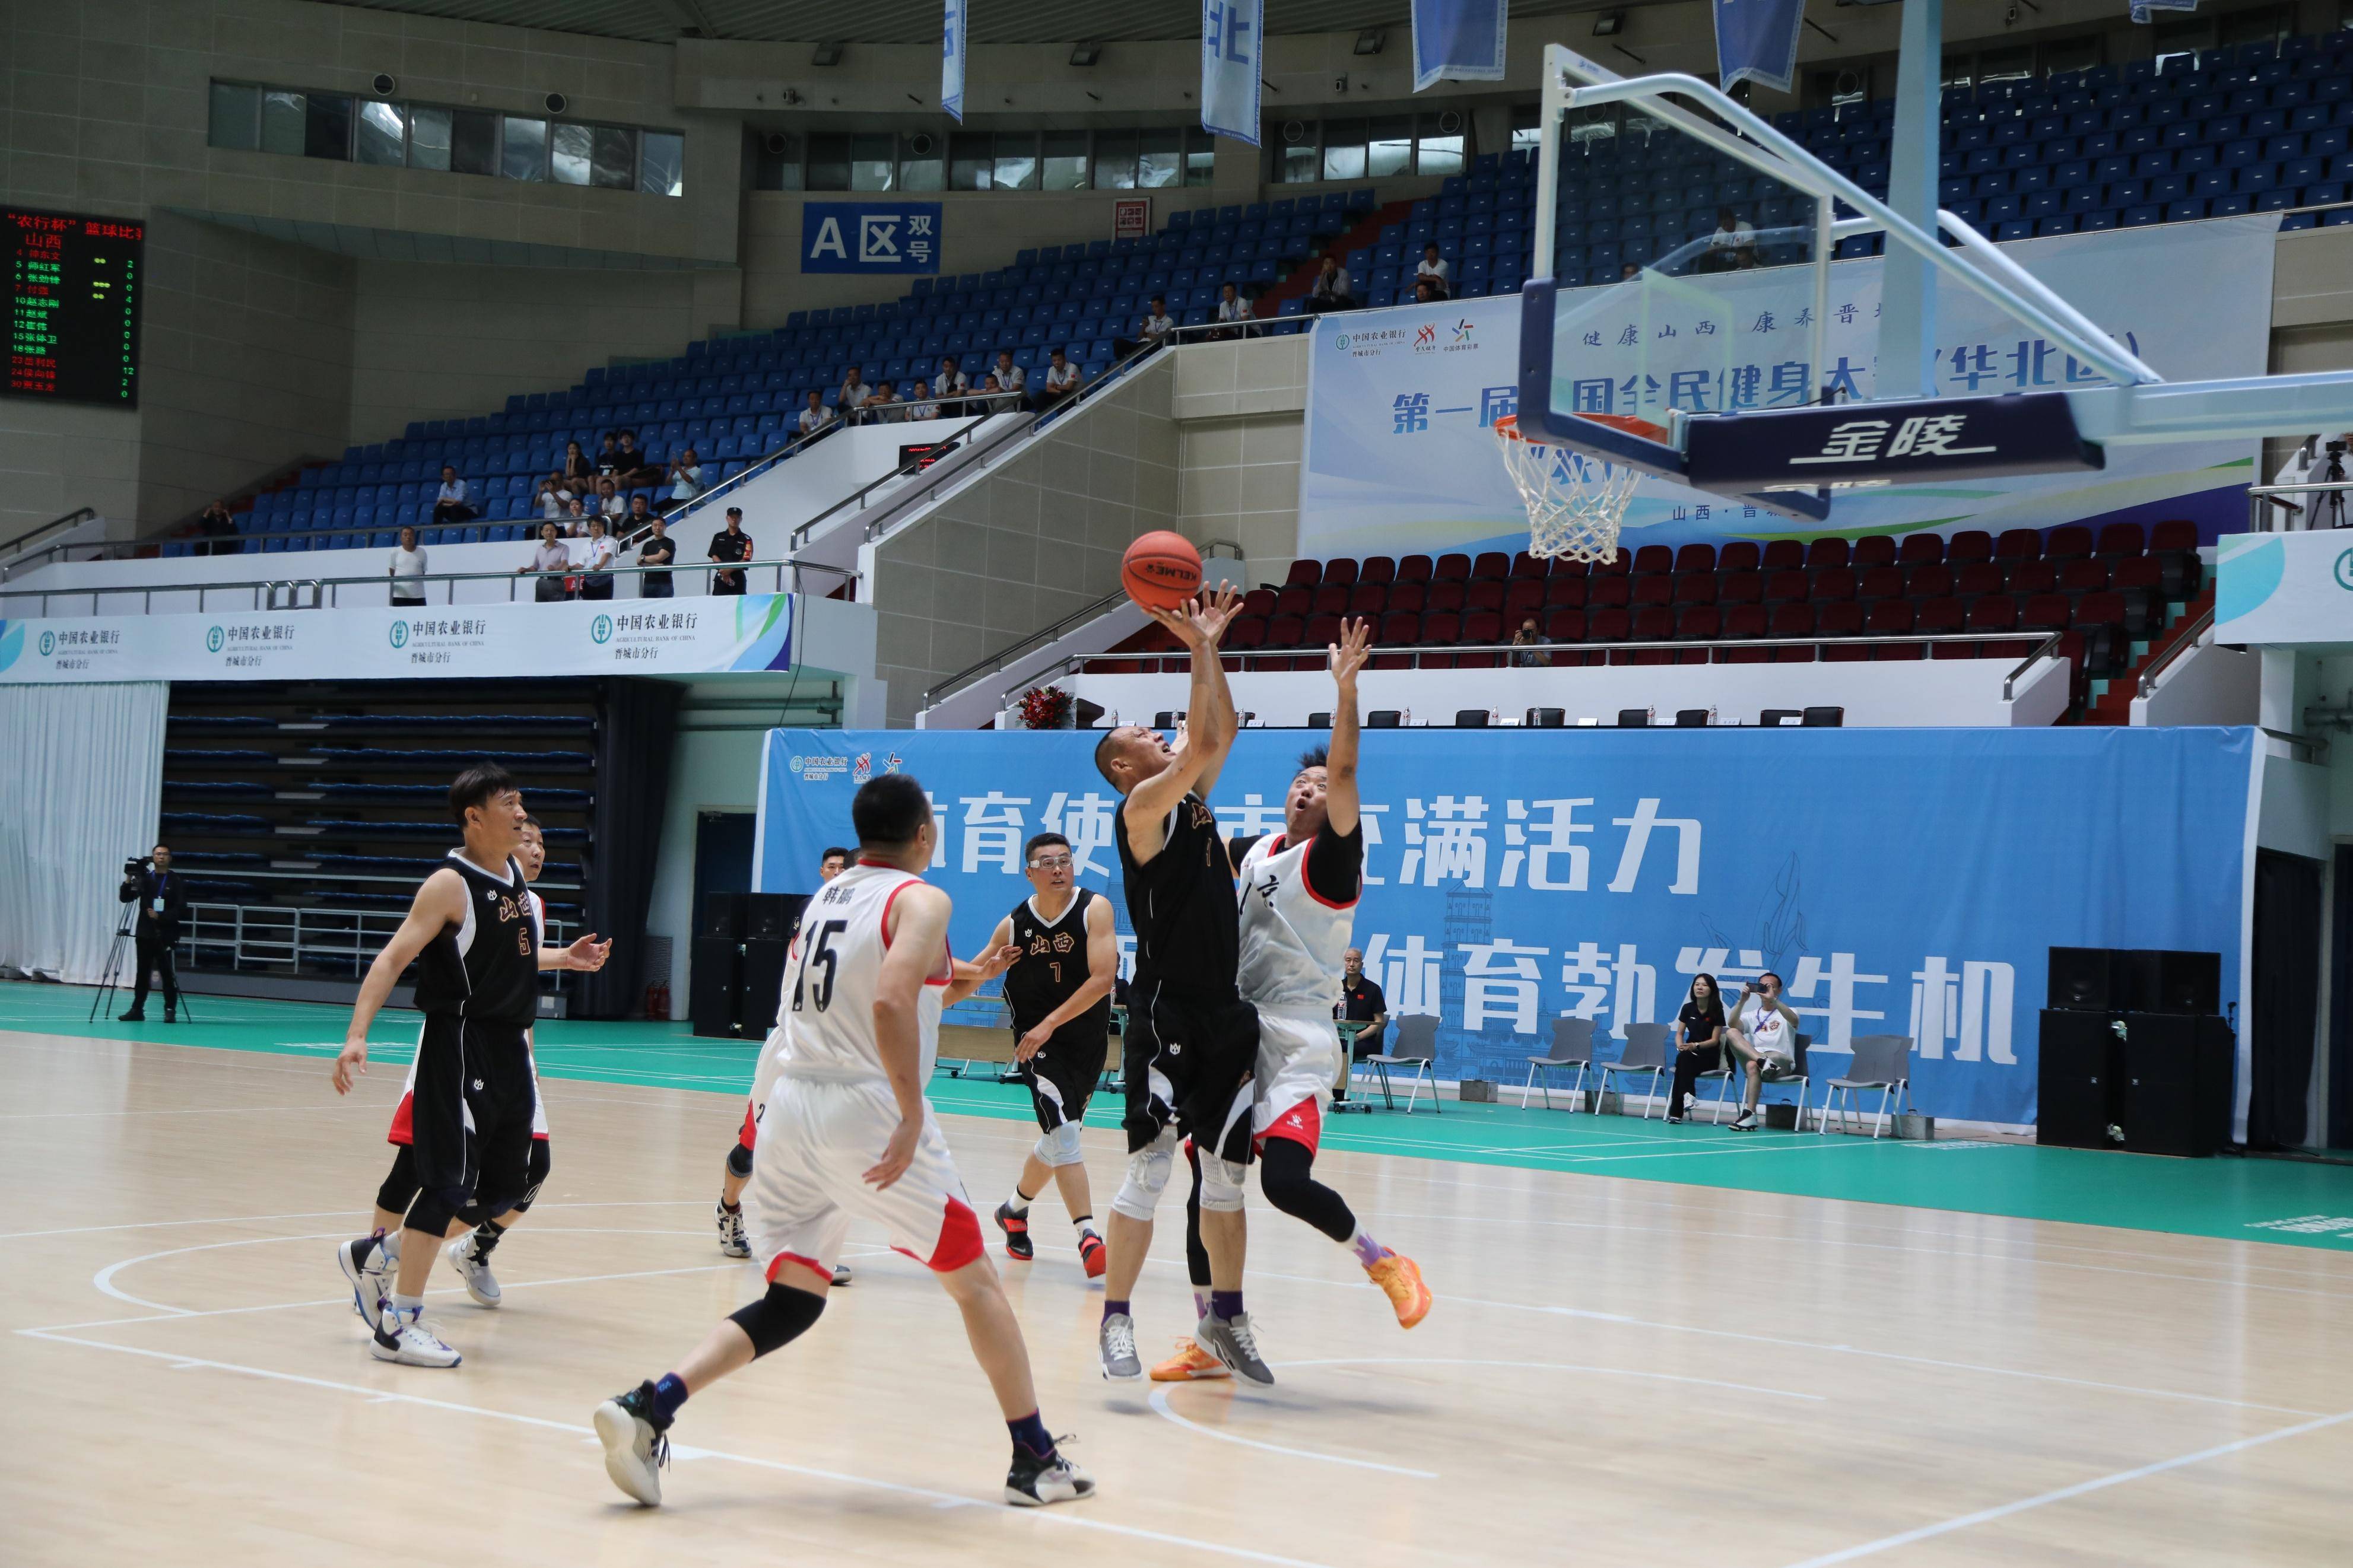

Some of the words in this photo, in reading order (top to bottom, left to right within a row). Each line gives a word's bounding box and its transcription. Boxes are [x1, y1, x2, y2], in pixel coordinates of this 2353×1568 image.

[26, 232, 62, 249] 山西
[1583, 320, 1716, 346] 健康山西
[1751, 303, 1881, 333] 康养晋
[1352, 329, 1406, 342] 中国农业银行
[1352, 349, 1381, 357] 晋城市分行
[1443, 343, 1478, 352] 中国体育彩票
[1789, 415, 1996, 465] 金陵
[1156, 565, 1197, 581] KELME
[413, 620, 486, 636] 中国农业银行
[617, 613, 697, 631] 中国农业银行
[59, 631, 120, 645] 中国农业银行
[228, 625, 295, 641] 中国农业银行
[226, 656, 262, 666] 晋城市分行
[411, 651, 451, 663] 晋城市分行
[615, 647, 658, 660] 晋城市分行
[56, 659, 90, 670] 晋城市分行
[805, 756, 848, 766] 中国农业银行
[499, 891, 532, 922] 山西
[519, 927, 531, 955] 5
[1030, 932, 1075, 955] 山西
[792, 920, 849, 1013] 15
[1050, 962, 1061, 982] 7
